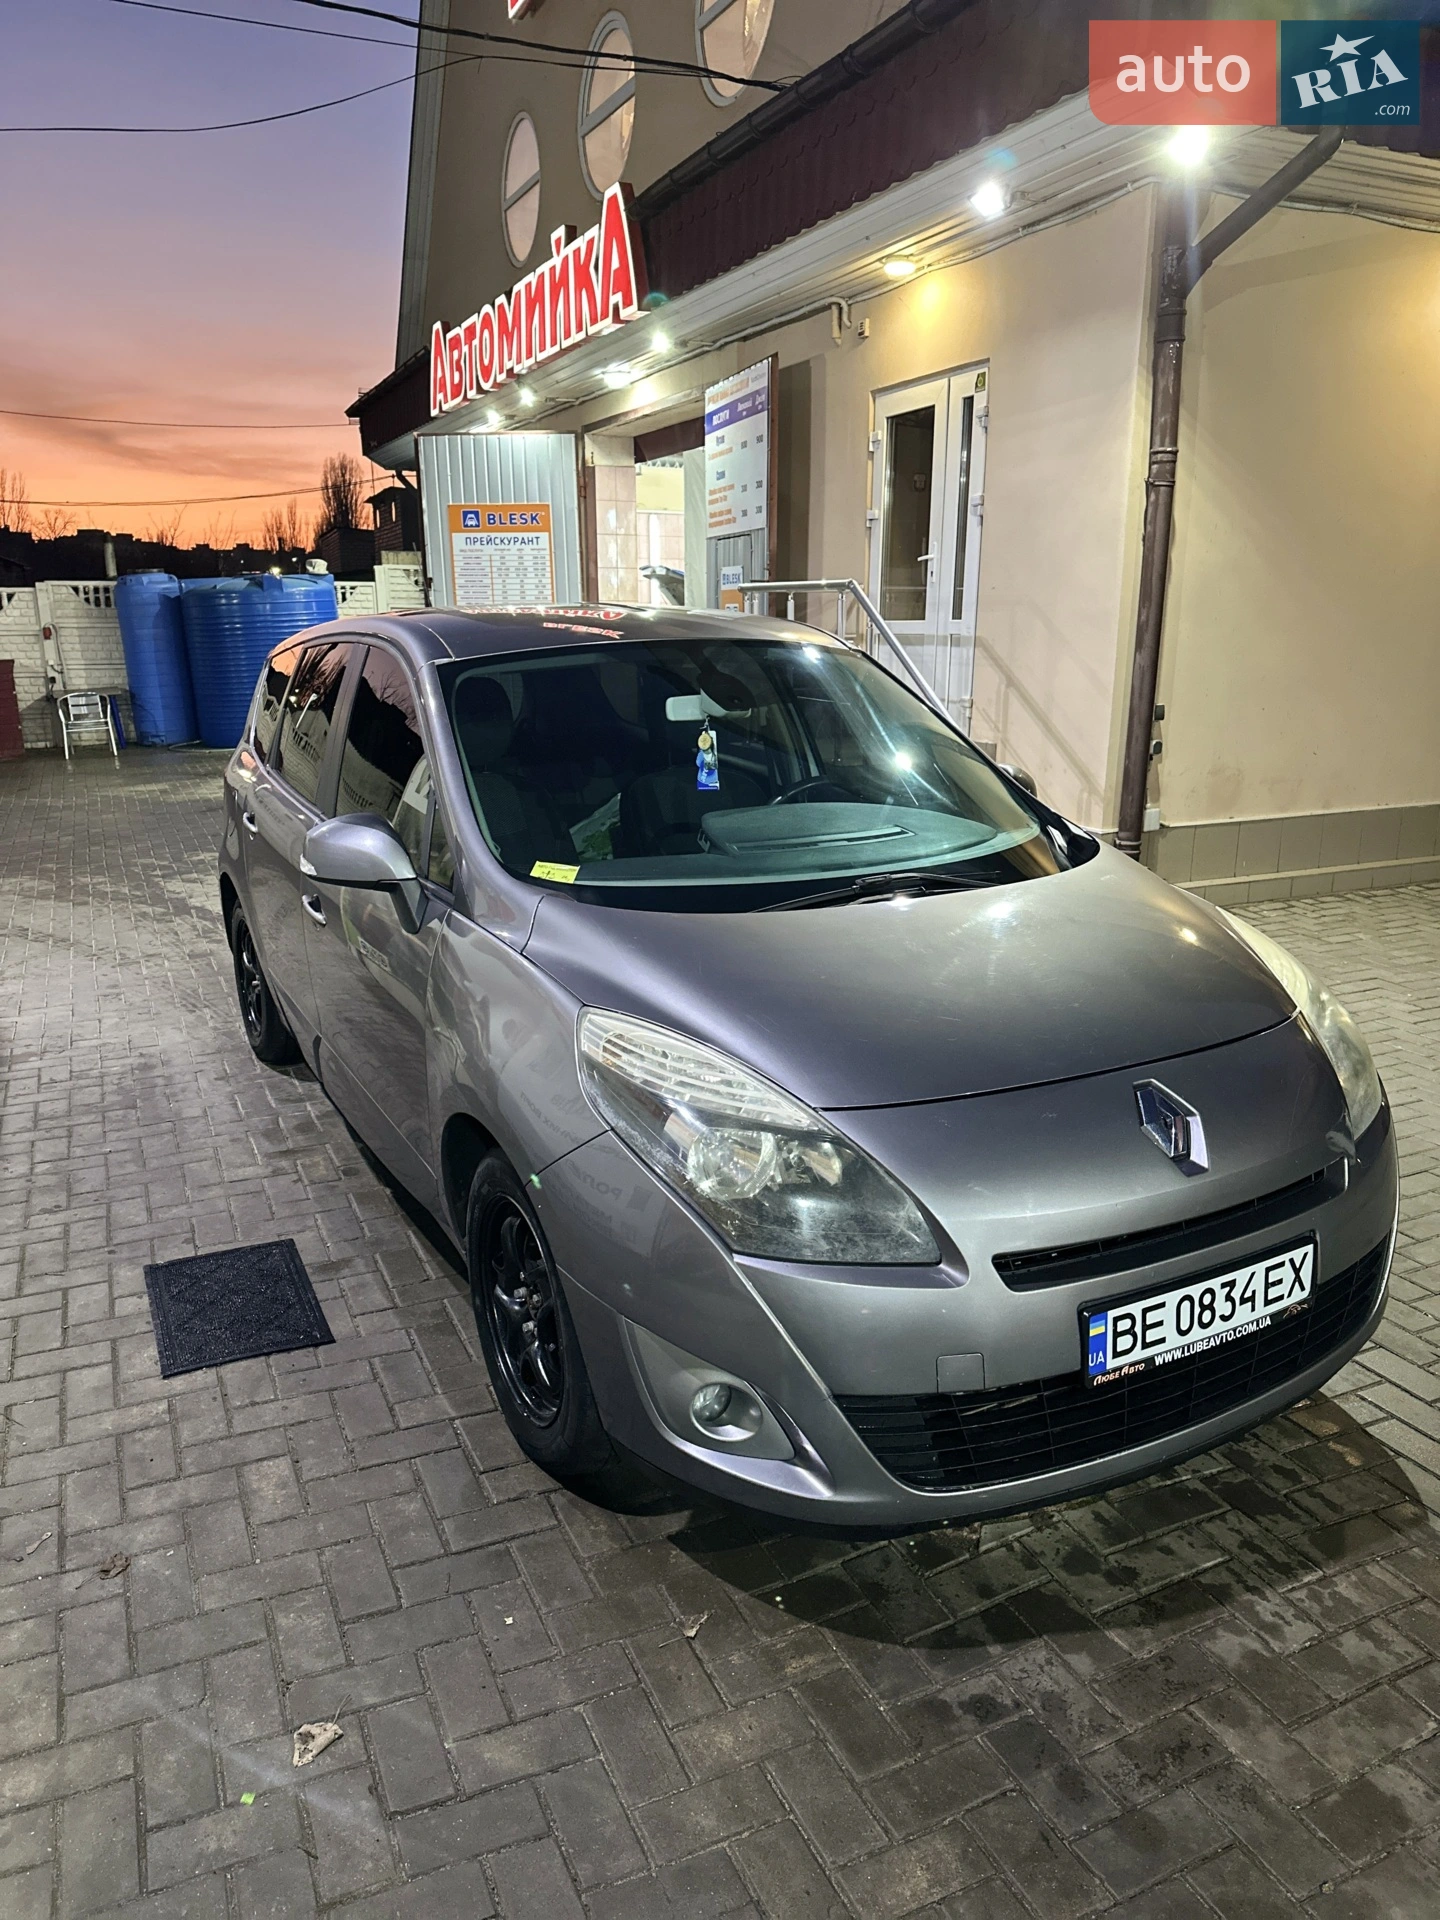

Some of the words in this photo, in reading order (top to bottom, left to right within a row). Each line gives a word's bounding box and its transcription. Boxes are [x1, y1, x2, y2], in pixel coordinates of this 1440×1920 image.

[430, 181, 640, 418] АВТОМИЙКА
[486, 512, 542, 526] BLESK
[465, 534, 541, 546] ПРЕЙСКУРАНТ
[1111, 1300, 1167, 1360] BE
[1175, 1271, 1256, 1337] 0834
[1263, 1251, 1309, 1308] EX
[1154, 1315, 1272, 1367] WWW.LUBEAVTO.COM.UA
[1088, 1350, 1105, 1367] UA
